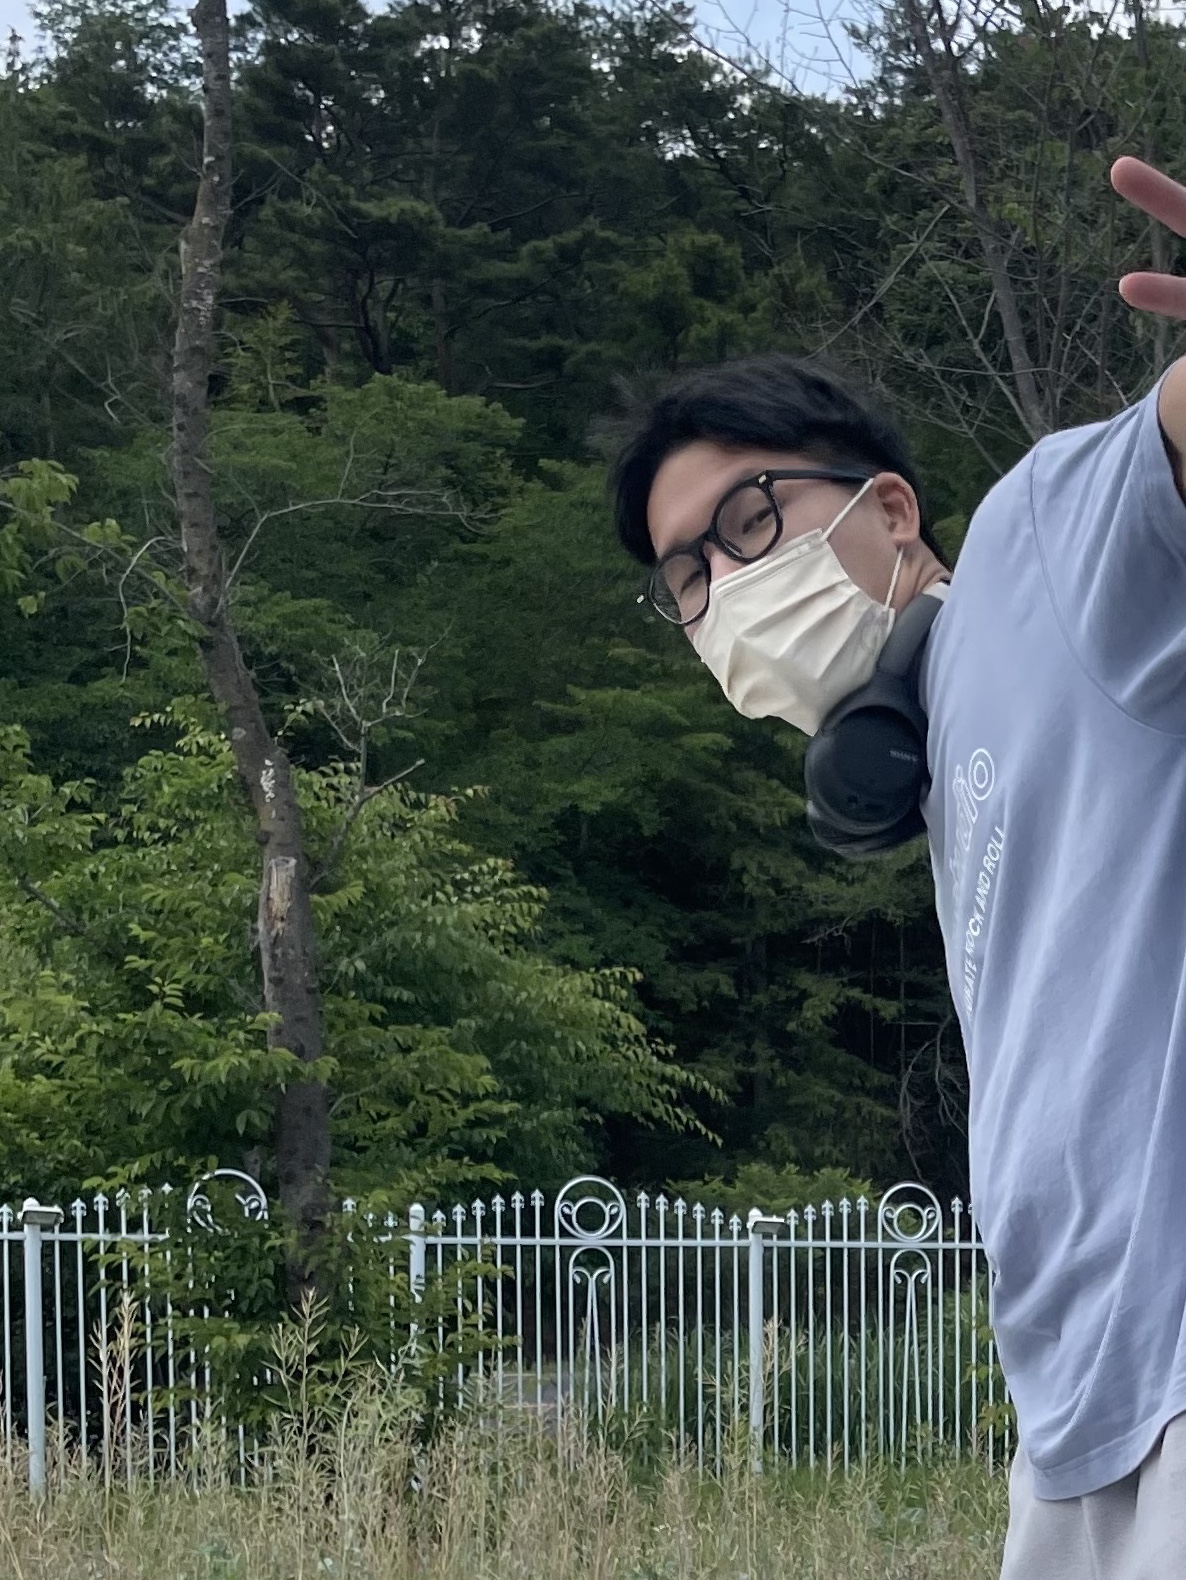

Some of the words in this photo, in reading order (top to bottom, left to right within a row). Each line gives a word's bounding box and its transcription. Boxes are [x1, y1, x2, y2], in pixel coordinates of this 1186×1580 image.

[983, 825, 1005, 875] ROLL
[974, 870, 991, 914] AND
[965, 905, 985, 957] ROCK
